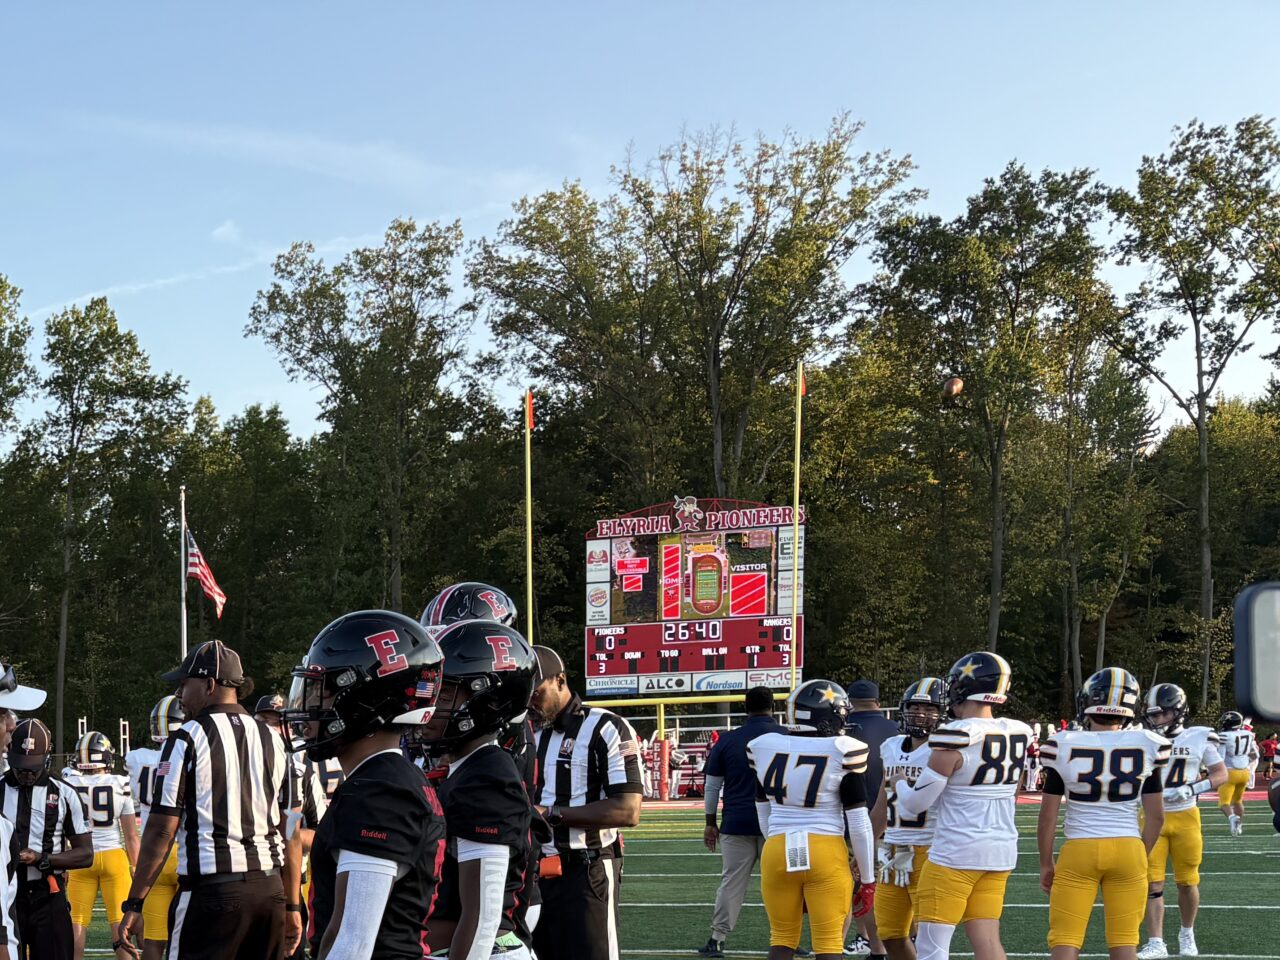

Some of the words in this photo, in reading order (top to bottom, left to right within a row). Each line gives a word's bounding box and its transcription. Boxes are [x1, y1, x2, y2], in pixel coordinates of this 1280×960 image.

[597, 516, 671, 537] ELYRIA
[706, 505, 804, 530] PIONEERS
[730, 564, 767, 572] VISITOR
[478, 590, 507, 619] E
[763, 618, 792, 626] RANGERS
[595, 627, 624, 635] PIONEERS
[665, 622, 720, 641] 26:40
[783, 627, 792, 640] 0
[606, 636, 614, 650] 0
[779, 644, 792, 652] TOL
[364, 629, 409, 677] E
[485, 635, 516, 671] E
[702, 647, 718, 655] BALL
[782, 654, 789, 665] 3
[599, 663, 605, 673] 3
[749, 672, 800, 682] EMC
[706, 680, 743, 690] Nordson
[1096, 706, 1127, 714] Riddell
[1234, 735, 1249, 756] 17
[970, 734, 1028, 785] 88
[886, 766, 922, 778] RANERS
[1068, 748, 1145, 802] 38
[138, 766, 157, 806] 1
[763, 753, 830, 808] 47
[360, 829, 388, 840] Riddell
